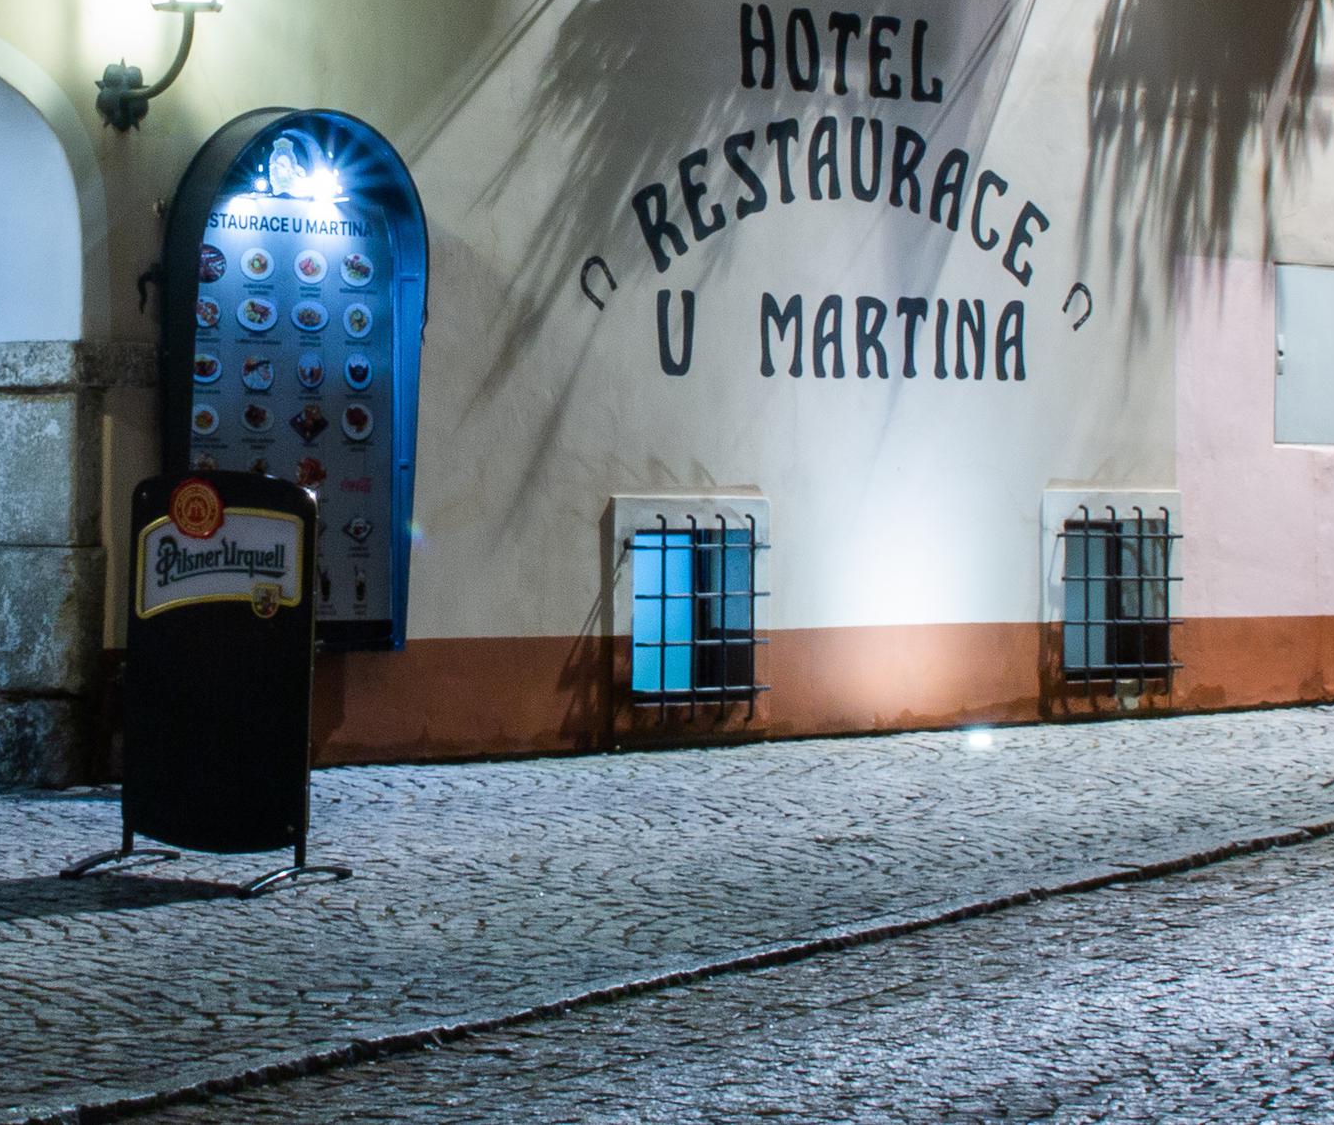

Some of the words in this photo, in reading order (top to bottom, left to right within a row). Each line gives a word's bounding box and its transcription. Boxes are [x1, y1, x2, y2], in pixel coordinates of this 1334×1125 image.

[740, 2, 944, 104] HOTEL
[204, 211, 289, 233] STAURACE
[292, 217, 302, 233] U
[305, 216, 373, 238] MARTINA
[632, 115, 1051, 286] RESTAURACE
[656, 288, 696, 377] U
[759, 292, 1028, 382] MARTINA
[155, 535, 222, 588] Pilsner
[222, 537, 285, 579] Urquell
